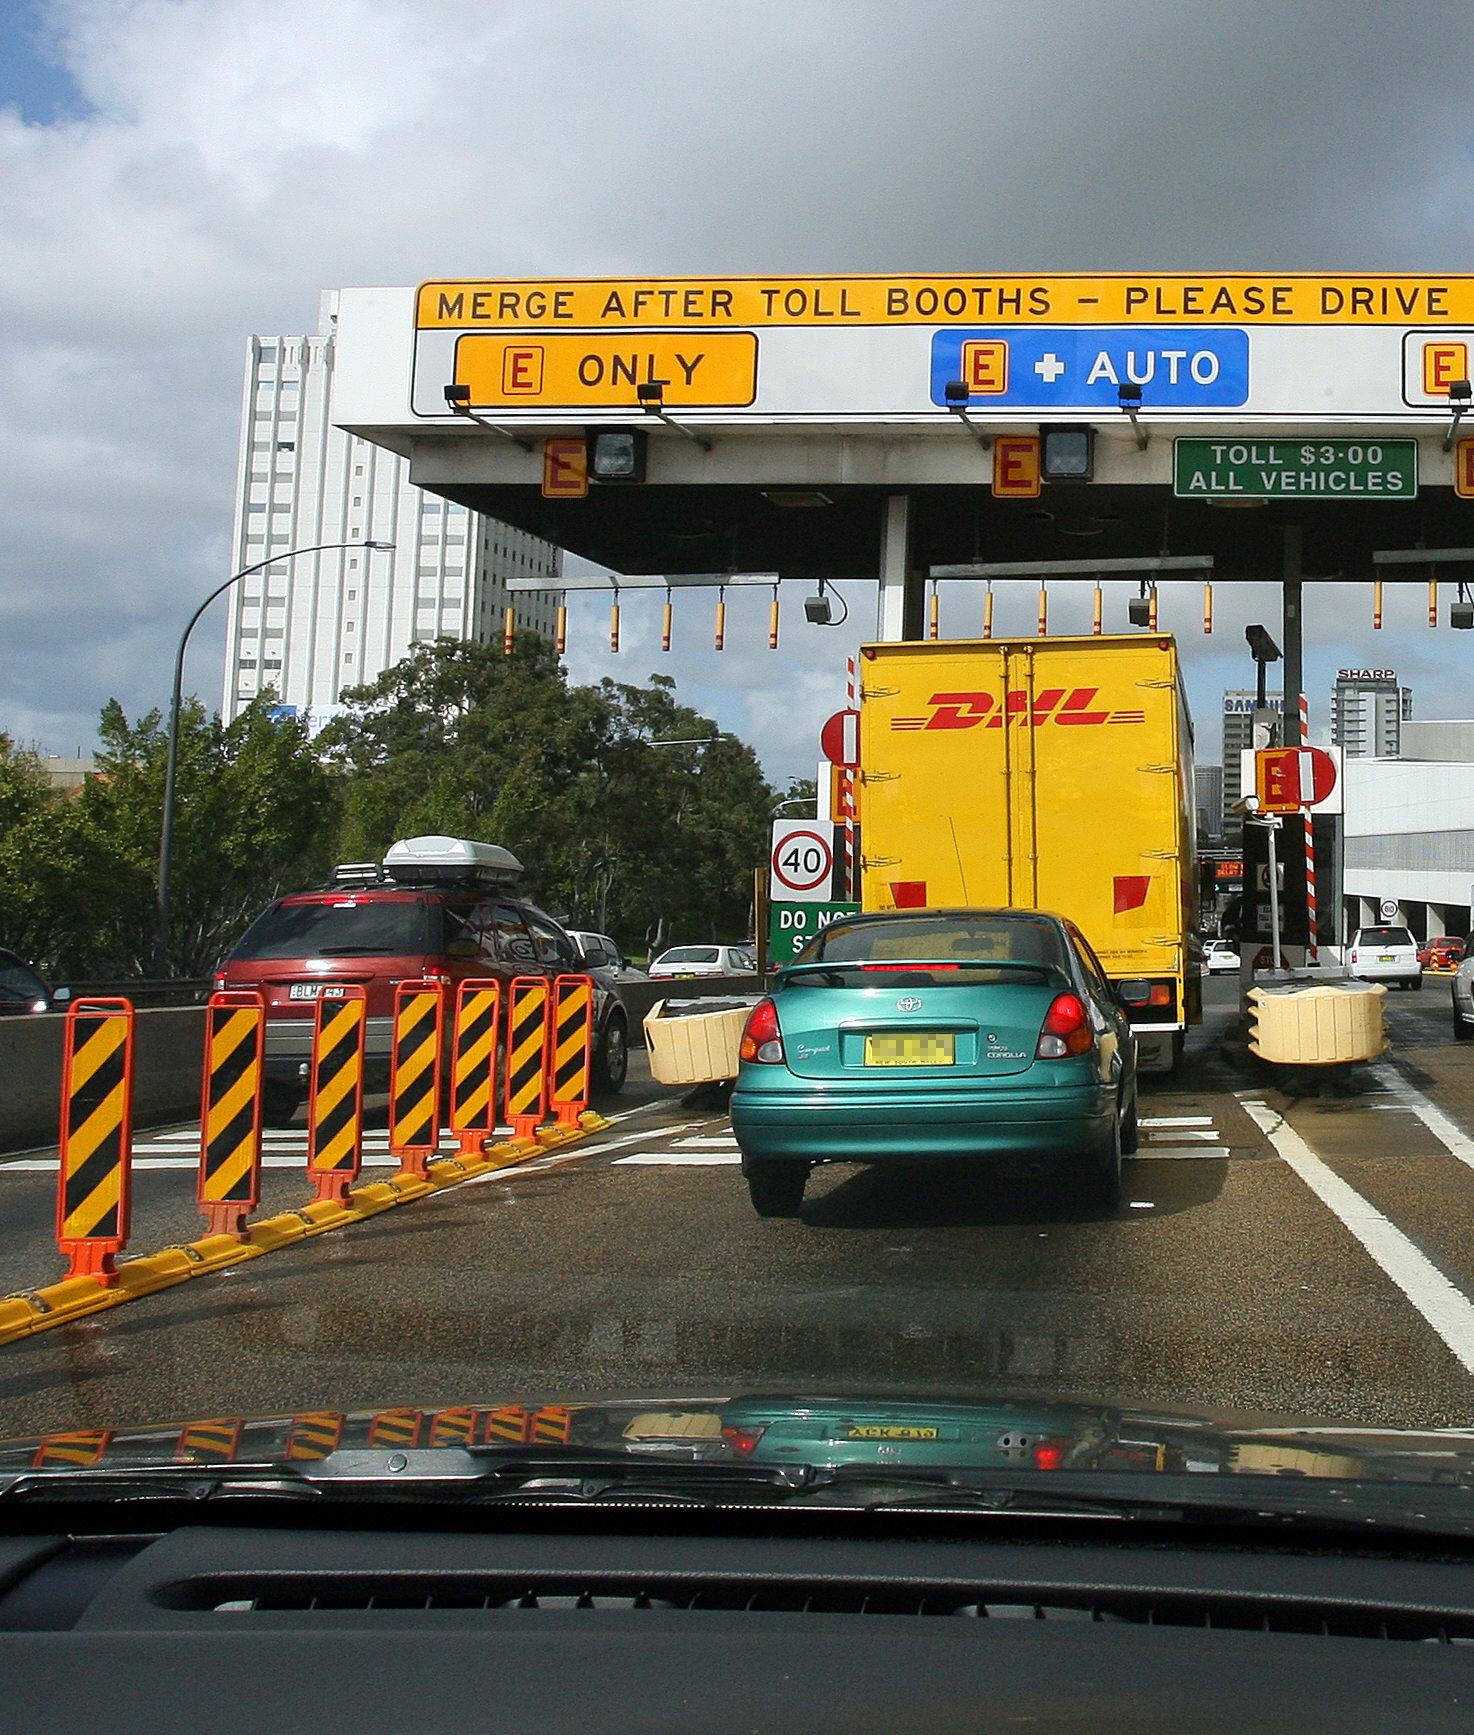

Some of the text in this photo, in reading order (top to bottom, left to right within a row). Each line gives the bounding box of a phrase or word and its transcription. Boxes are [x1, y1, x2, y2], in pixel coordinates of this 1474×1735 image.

[438, 292, 574, 319] MERGE
[601, 290, 733, 318] AFTER
[761, 289, 860, 316] TOLL
[887, 288, 1050, 315] BOOTHS
[1126, 287, 1293, 314] PLEASE
[1322, 287, 1448, 315] DRIVE
[512, 353, 704, 388] E ONLY
[973, 350, 995, 385] E
[1087, 351, 1220, 385] AUTO
[1434, 351, 1456, 387] E
[550, 446, 582, 489] E
[1001, 443, 1033, 489] E
[1211, 446, 1283, 464] TOLL
[1189, 472, 1403, 491] ALL VEHICLES
[1338, 669, 1395, 679] SHARP
[924, 688, 1110, 730] DHL
[783, 848, 820, 873] 40
[781, 911, 806, 928] DO
